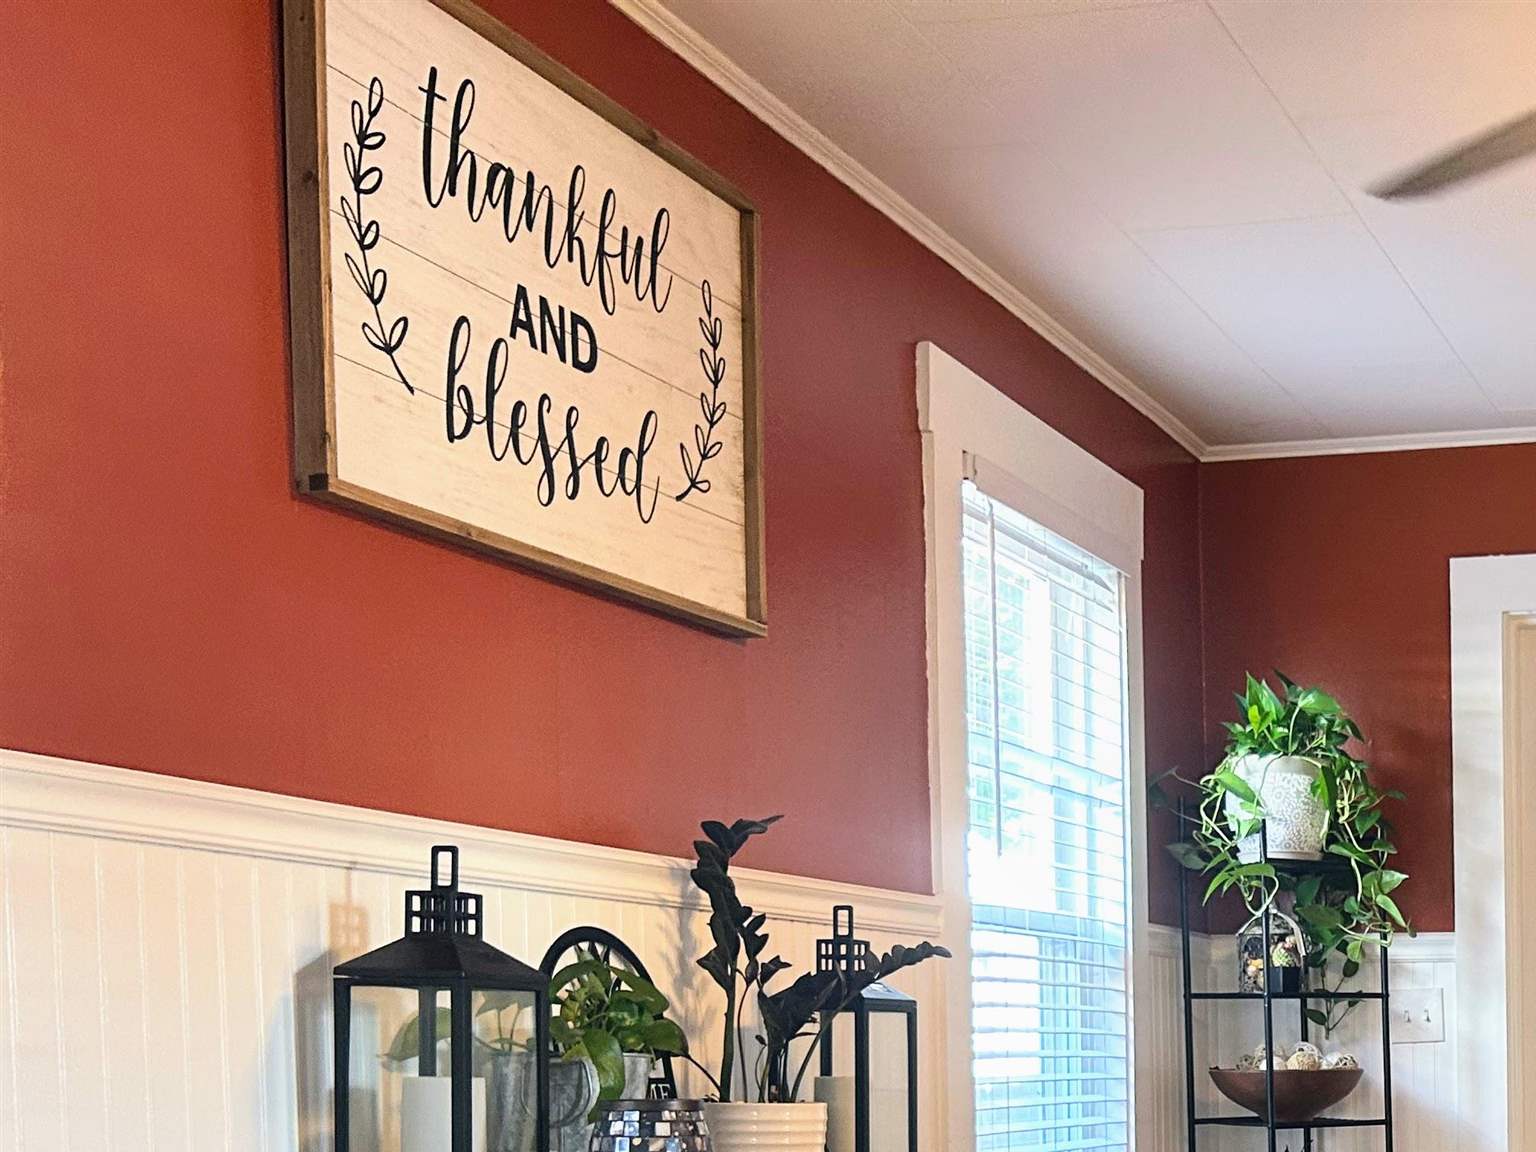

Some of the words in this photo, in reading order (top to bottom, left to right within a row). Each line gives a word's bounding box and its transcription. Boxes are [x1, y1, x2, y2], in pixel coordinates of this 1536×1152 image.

[419, 66, 673, 315] thankful
[446, 316, 661, 524] blessed
[509, 284, 598, 373] AND
